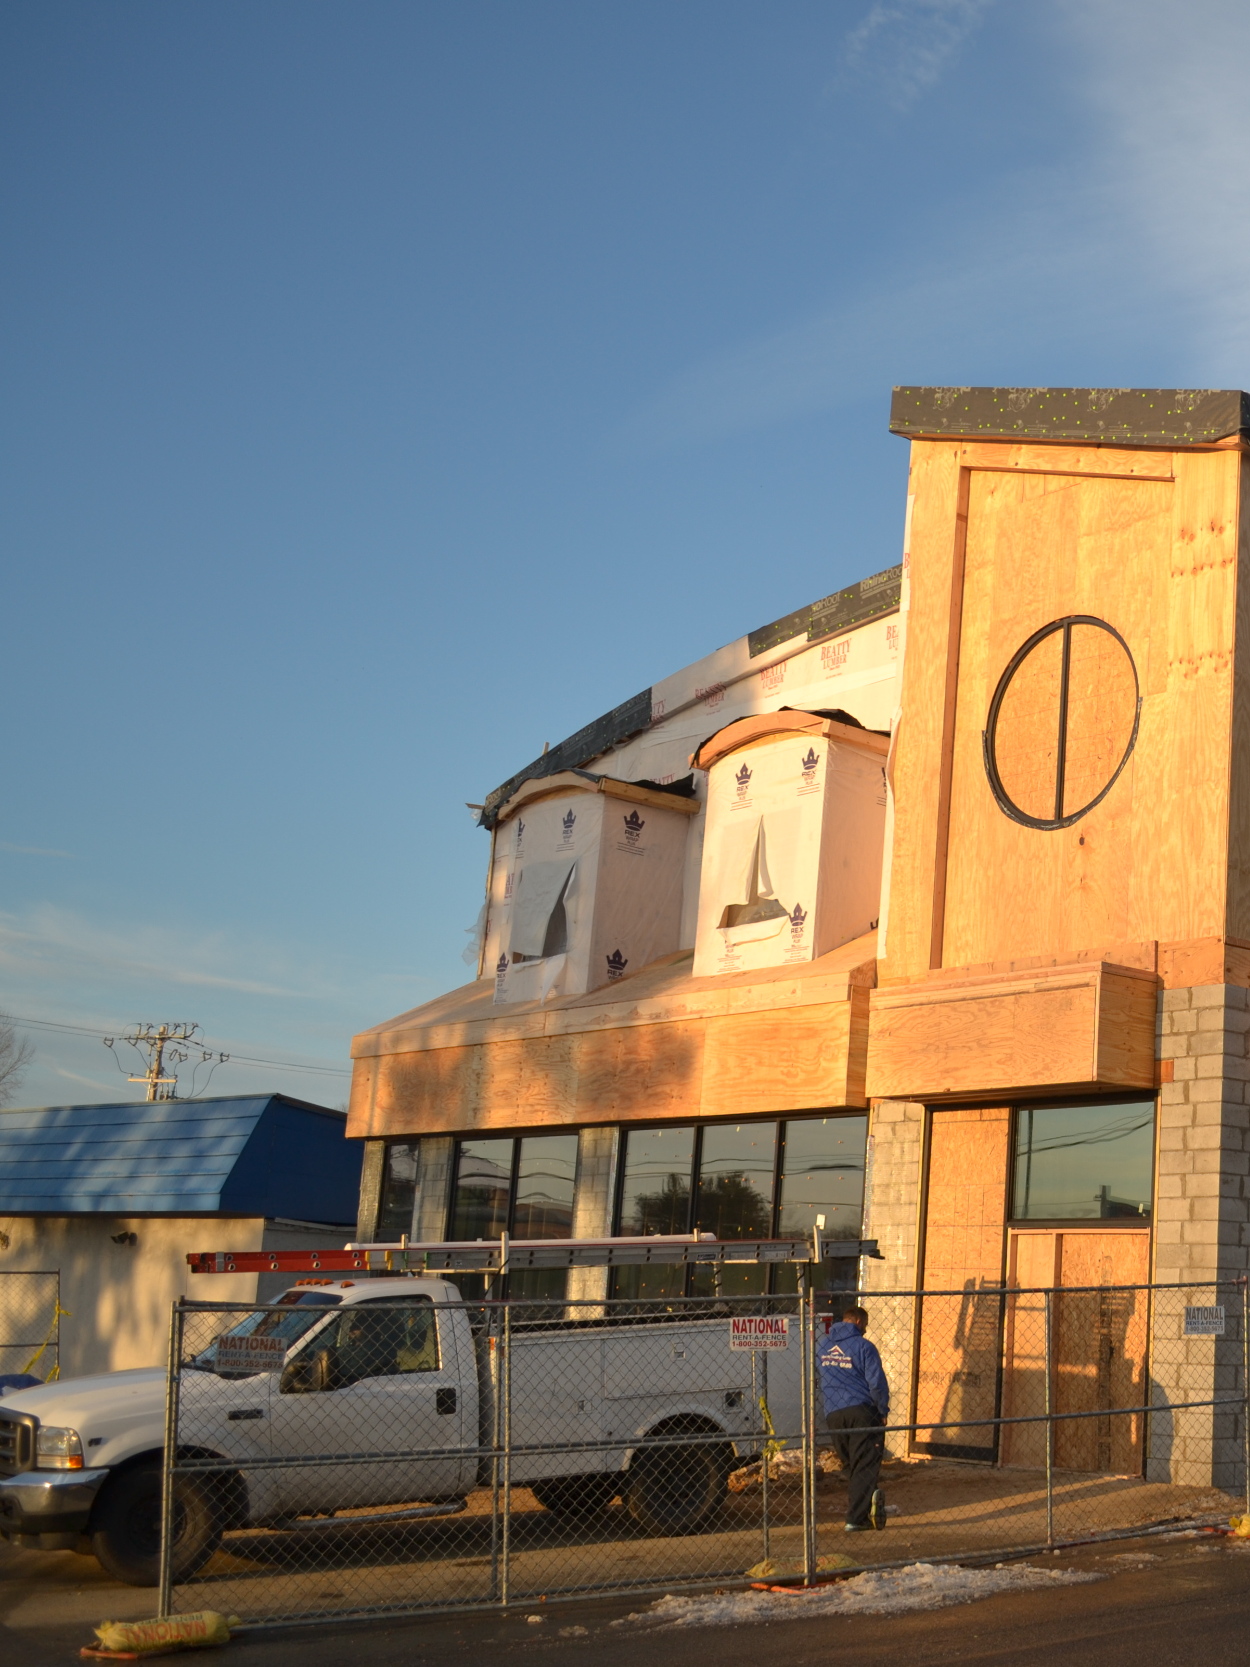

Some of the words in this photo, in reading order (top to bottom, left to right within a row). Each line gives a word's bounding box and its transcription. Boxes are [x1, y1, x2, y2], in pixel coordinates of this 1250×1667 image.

[821, 638, 852, 661] BEATTY
[823, 654, 847, 670] LUMBER
[624, 829, 641, 838] REX
[791, 926, 804, 934] REX
[607, 968, 624, 977] REX
[1186, 1307, 1224, 1320] NATIONAL
[732, 1318, 787, 1334] NATIONAL
[219, 1336, 284, 1352] NATIONAL
[218, 1350, 284, 1360] RENT-A-FENCE
[118, 1620, 207, 1643] NATIONAL
